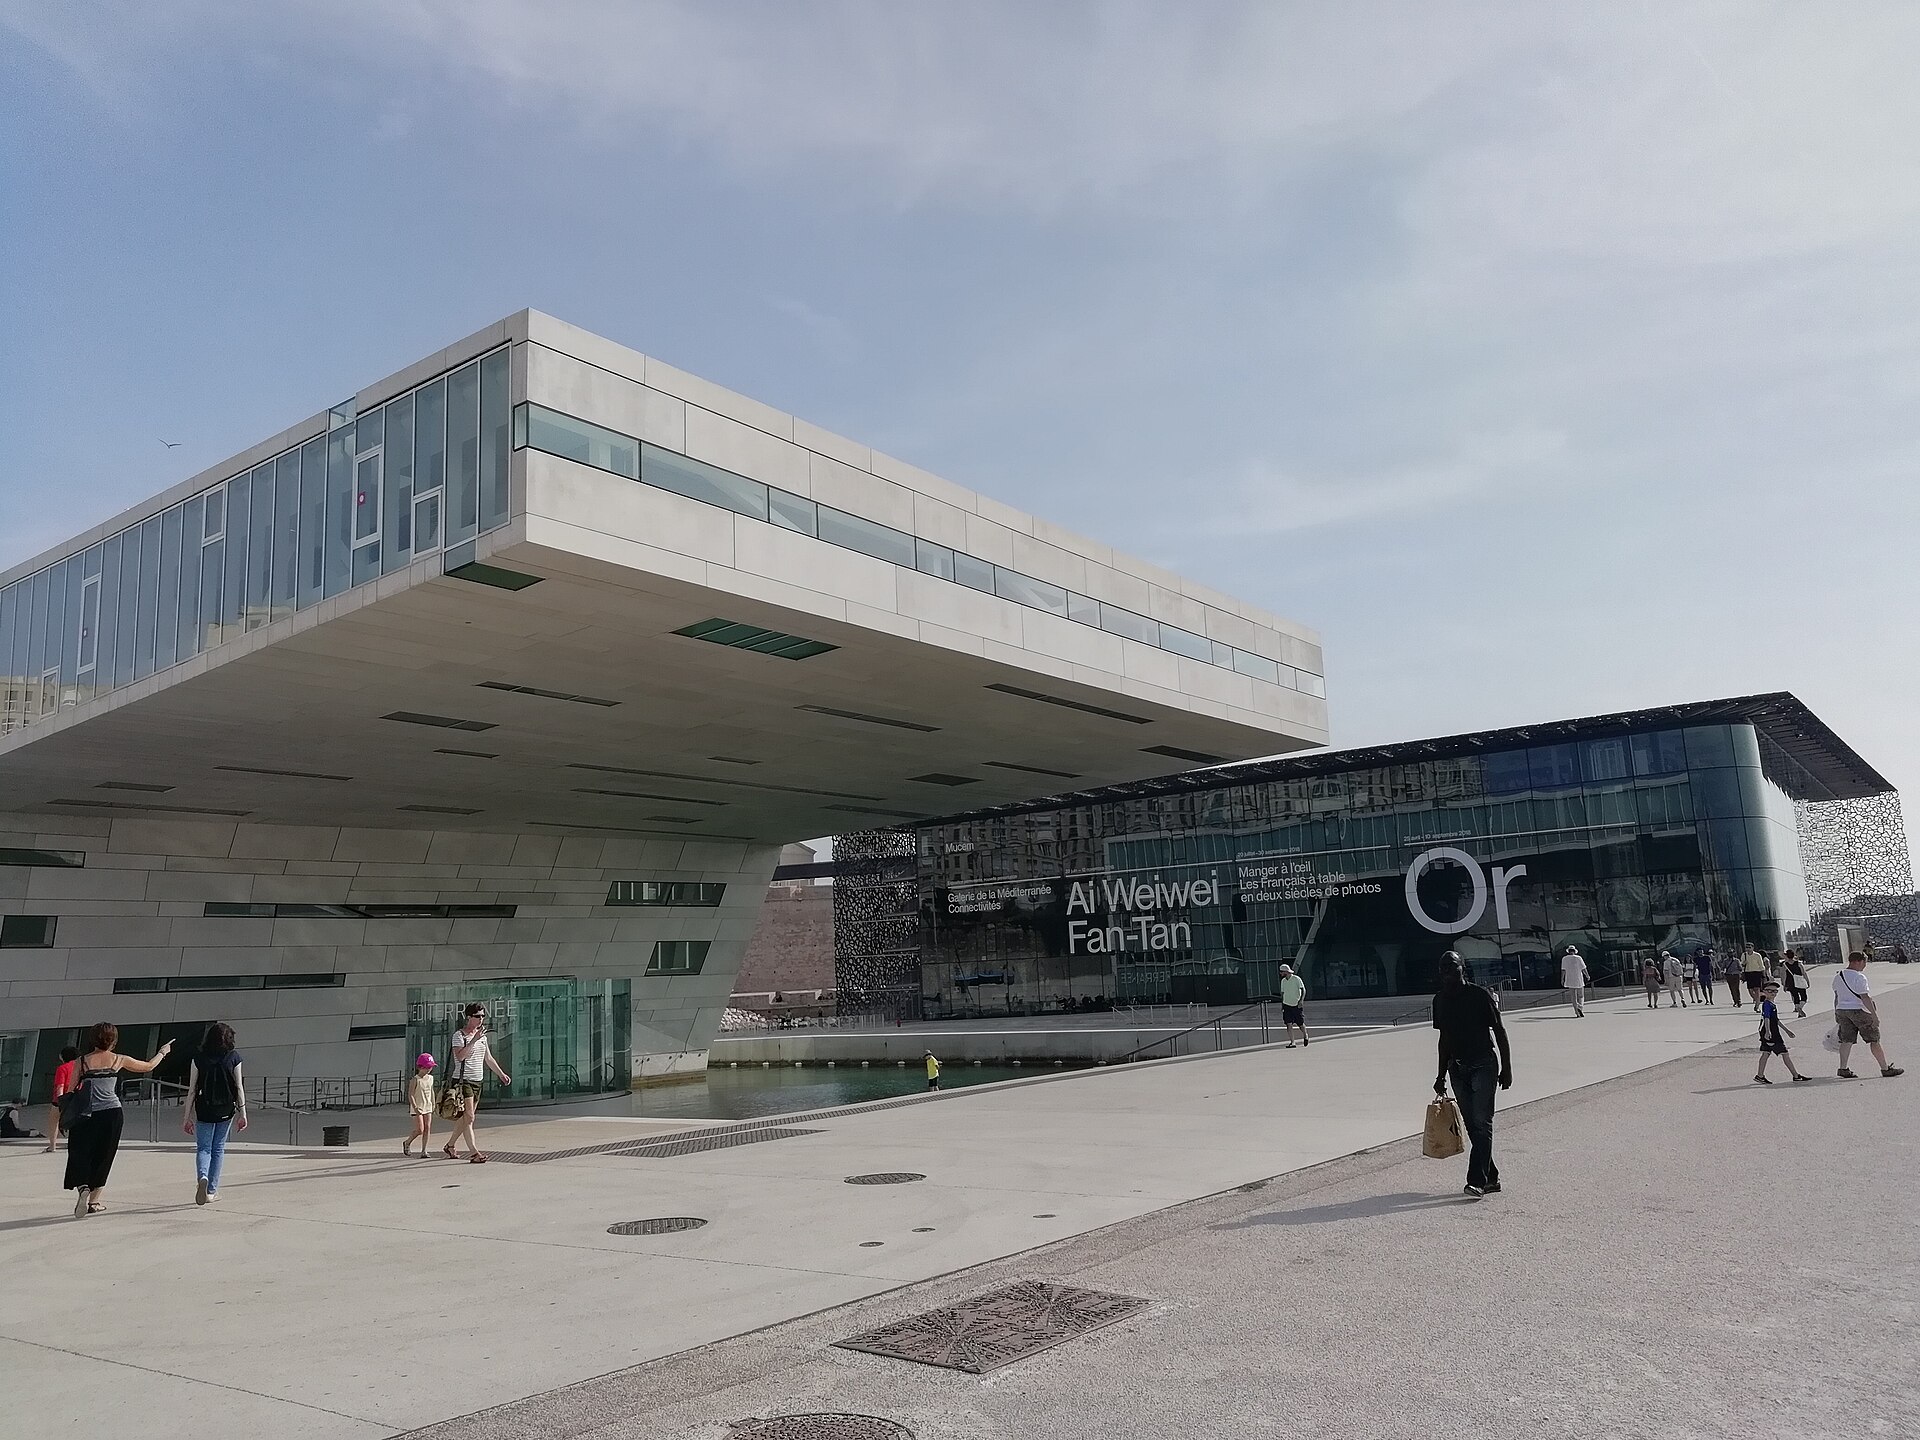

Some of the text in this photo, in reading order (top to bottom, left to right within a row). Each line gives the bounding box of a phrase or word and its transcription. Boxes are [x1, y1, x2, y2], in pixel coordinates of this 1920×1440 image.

[945, 842, 975, 853] Mucem
[1238, 866, 1279, 879] Manger
[1281, 862, 1289, 873] à
[1239, 871, 1346, 890] Les Français à table
[1405, 846, 1527, 934] Or
[947, 885, 1052, 903] Galerie de la Méditerranée
[1066, 869, 1219, 915] Ai Weiwei
[1240, 883, 1382, 903] en deux siècles de photos
[948, 901, 1002, 914] Connectivités
[1068, 916, 1192, 954] Fan-Tan
